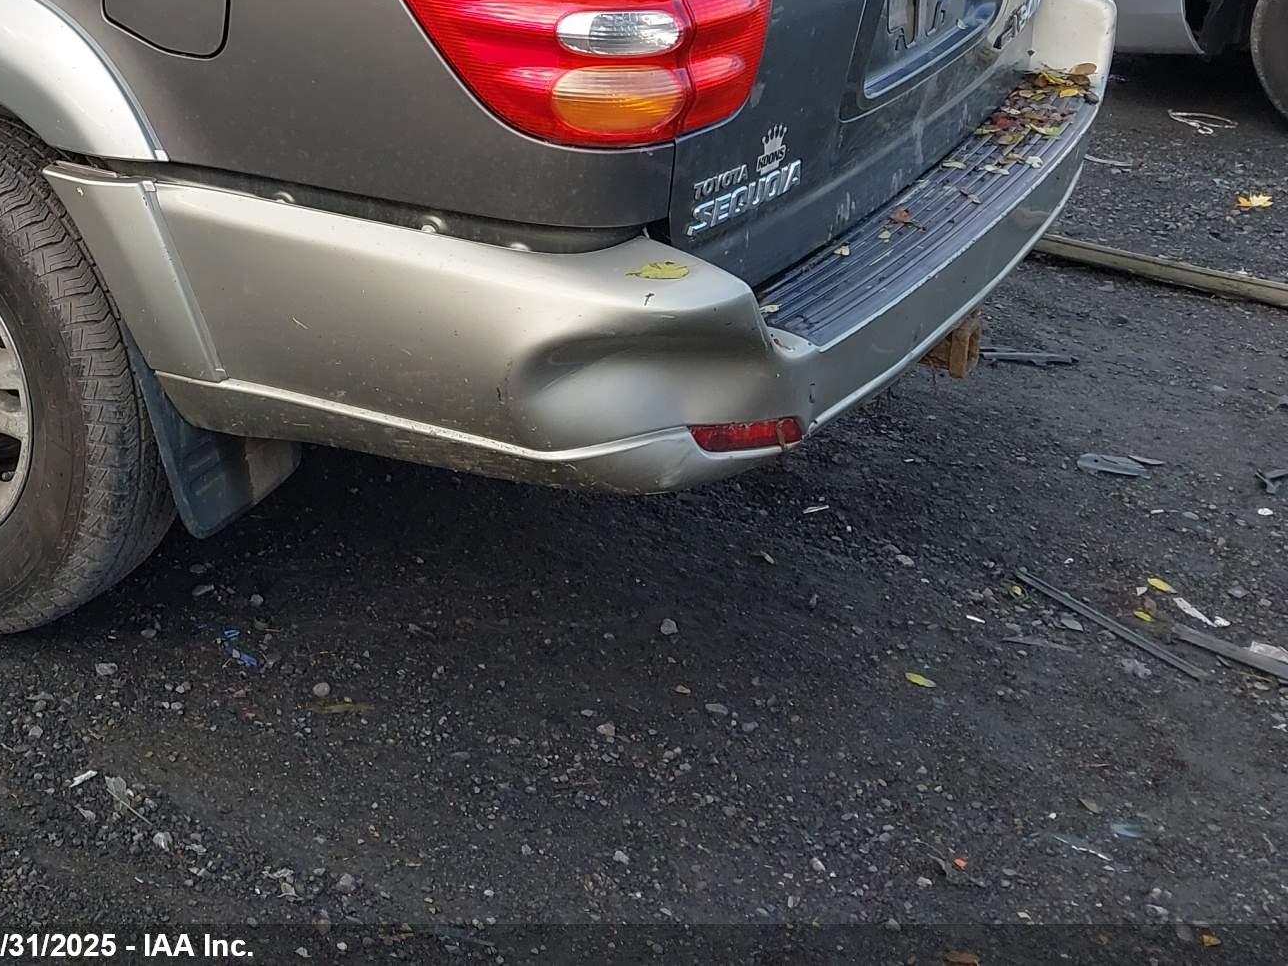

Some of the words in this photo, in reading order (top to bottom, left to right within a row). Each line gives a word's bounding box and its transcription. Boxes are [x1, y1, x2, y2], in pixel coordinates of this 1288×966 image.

[757, 146, 786, 170] KOONS
[687, 159, 801, 236] SEQUOIA
[694, 164, 749, 200] TOYOTA
